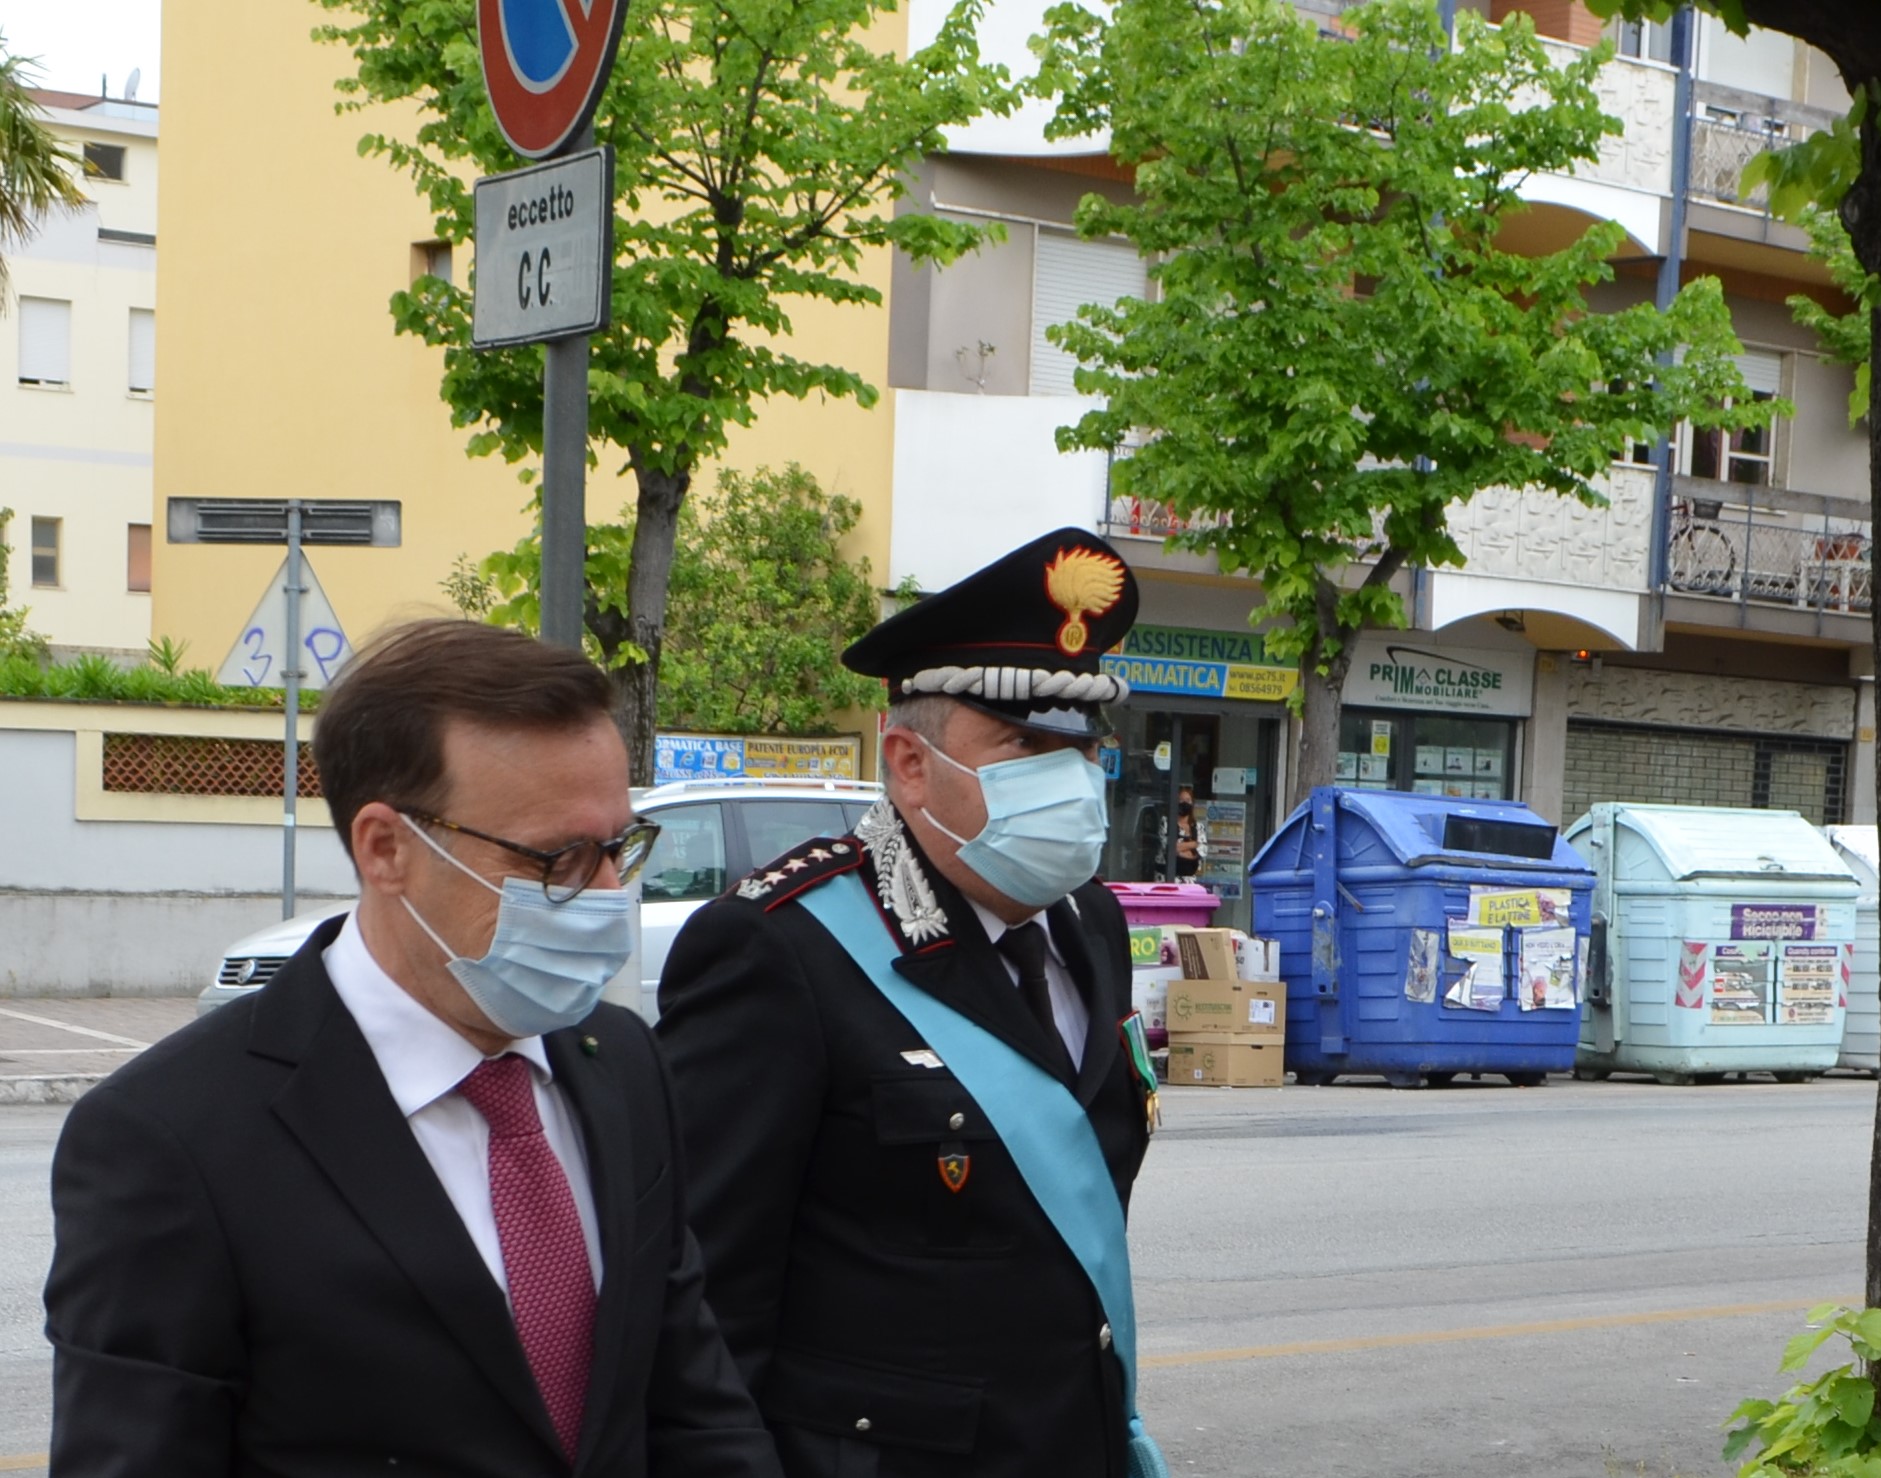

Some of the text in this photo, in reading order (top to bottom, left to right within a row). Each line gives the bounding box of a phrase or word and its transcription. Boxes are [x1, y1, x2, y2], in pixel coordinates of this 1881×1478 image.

[507, 183, 575, 231] eccetto
[1126, 629, 1252, 662] ASSISTENZA
[243, 627, 272, 686] 3
[1435, 668, 1502, 689] CLASSE
[715, 741, 743, 753] BASE
[748, 743, 785, 754] PATENTE
[1489, 897, 1530, 911] PLASTICA
[1743, 908, 1777, 921] Secco
